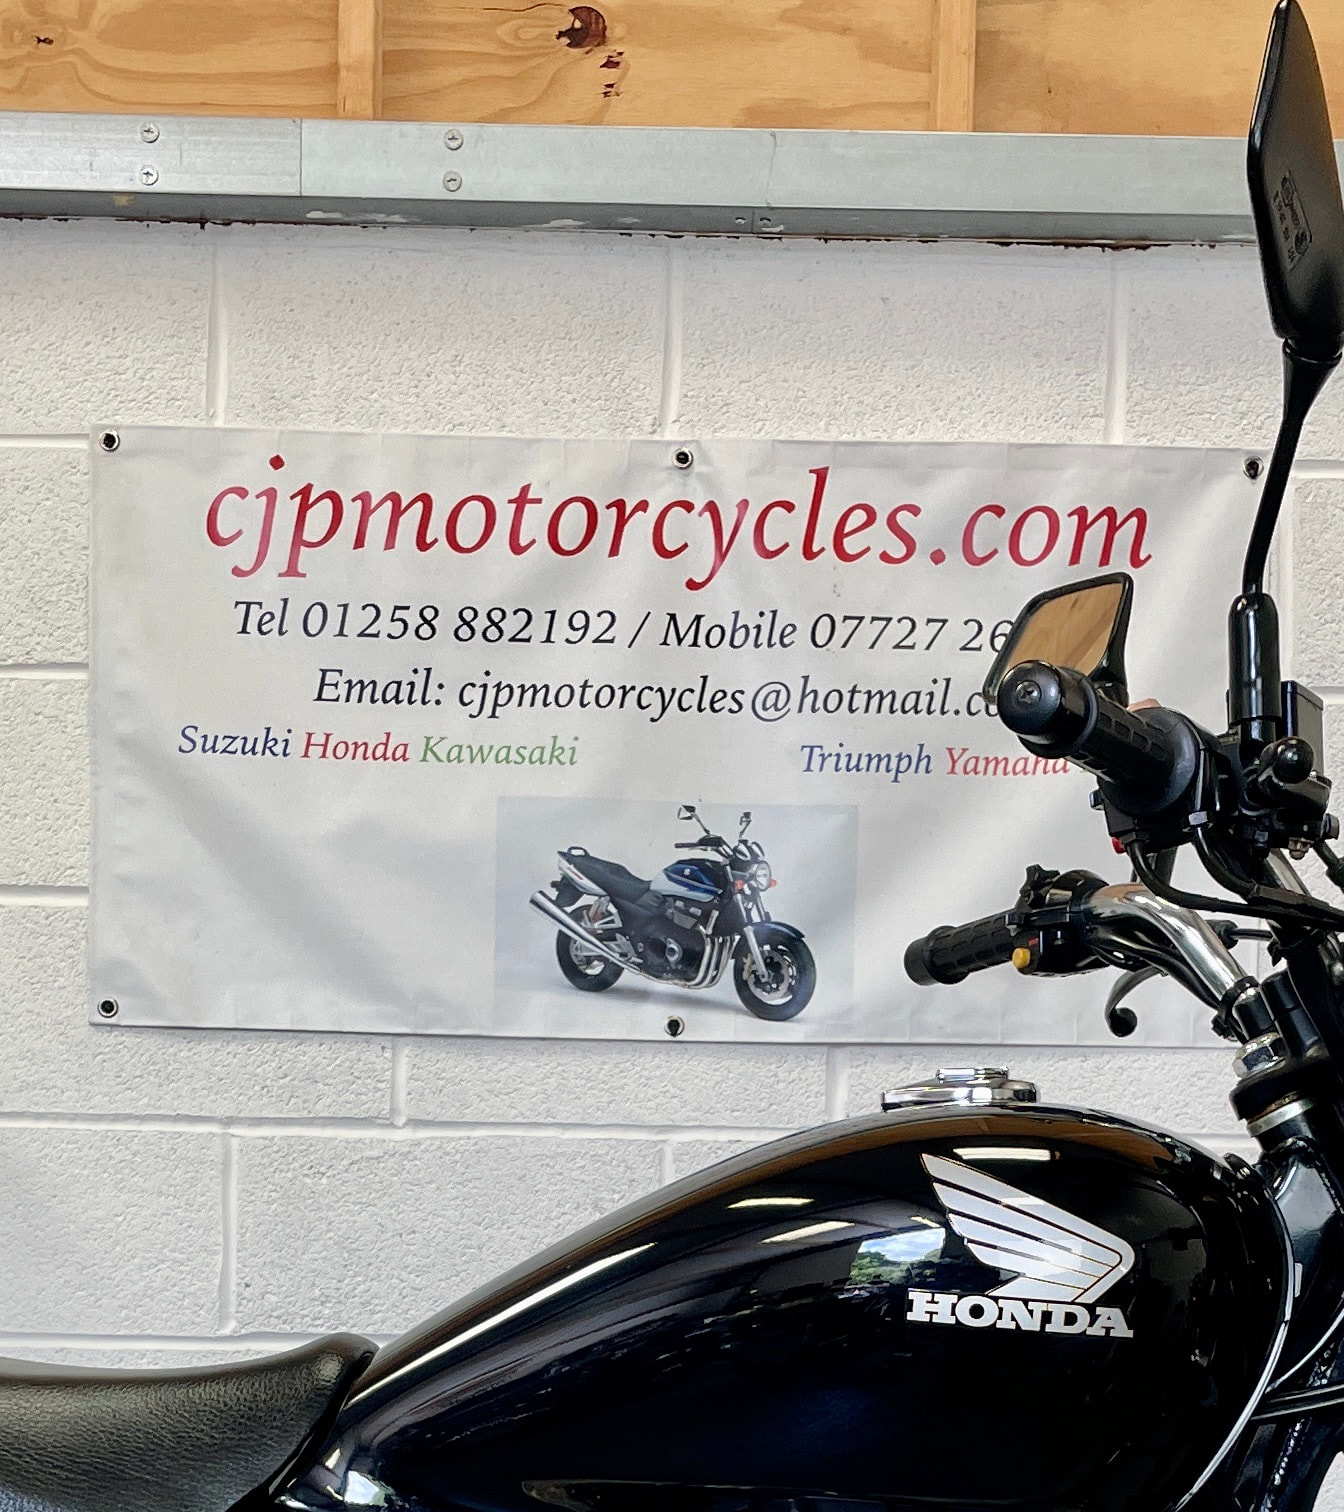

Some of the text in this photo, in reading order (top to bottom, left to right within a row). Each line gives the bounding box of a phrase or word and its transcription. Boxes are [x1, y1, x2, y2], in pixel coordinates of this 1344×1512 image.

[205, 454, 1153, 592] cjpmotorcycles.com
[234, 597, 290, 637] Tel
[302, 602, 440, 642] 01258
[454, 605, 617, 645] 882192
[628, 610, 652, 649] /
[658, 609, 798, 651] Mobile
[810, 613, 949, 652] 07727
[313, 667, 445, 706] Email:
[178, 724, 579, 767] Suzuki Honda Kawasaki
[800, 743, 933, 783] Triumph
[906, 1291, 1134, 1338] HONDA
